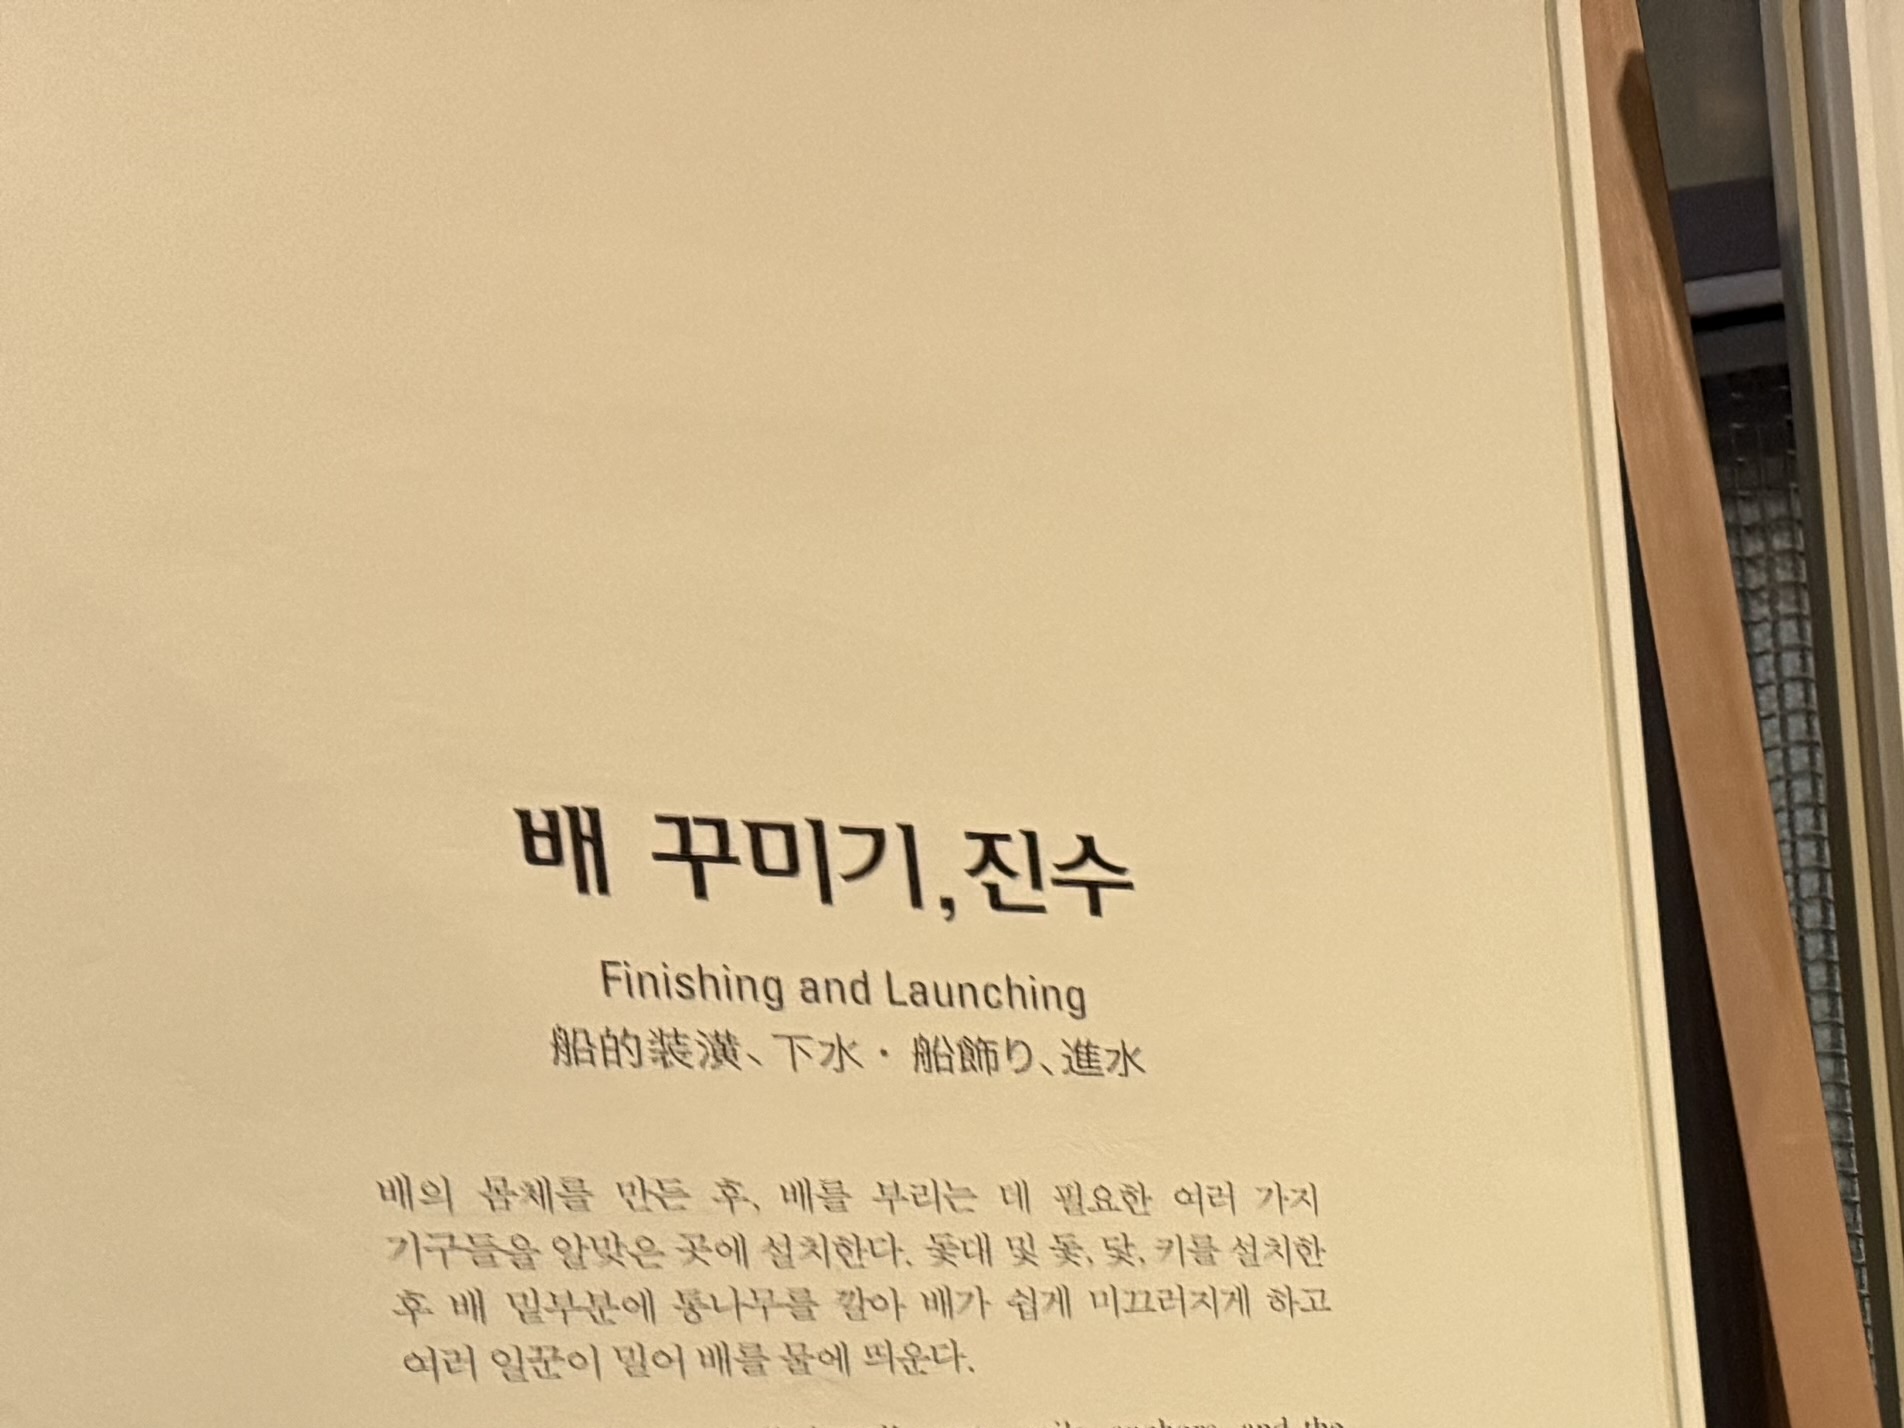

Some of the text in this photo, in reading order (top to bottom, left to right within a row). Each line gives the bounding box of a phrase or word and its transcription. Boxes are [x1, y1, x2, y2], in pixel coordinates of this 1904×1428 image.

[512, 804, 611, 897] 배
[600, 959, 1087, 1021] Finishing and Launching
[375, 1172, 455, 1217] 배의
[477, 1175, 595, 1216] 몸체를
[615, 1174, 692, 1213] 만든
[779, 1176, 853, 1215] 배를
[872, 1177, 979, 1217] 부리는
[998, 1178, 1031, 1216] 데
[1053, 1179, 1154, 1217] 필요한
[1173, 1180, 1236, 1218] 여러
[1255, 1179, 1319, 1218] 가지
[386, 1229, 542, 1272] 기구들을
[551, 1229, 667, 1271] 알맞은
[674, 1231, 750, 1271] 곳에
[761, 1230, 914, 1270] 설치한다.
[924, 1231, 994, 1269] 돛대
[1005, 1230, 1040, 1268] 및
[1154, 1232, 1222, 1269] 키를
[1232, 1232, 1327, 1270] 설치한
[391, 1282, 1333, 1329] 후 배 밑부분에 통나무를 깔아 배가 쉽게 미끄러지게 하고
[402, 1343, 478, 1385] 여러
[611, 1341, 687, 1381] 밀어
[695, 1339, 772, 1378] 배를
[777, 1340, 851, 1378] 물에
[863, 1337, 975, 1377] 띄운다.
